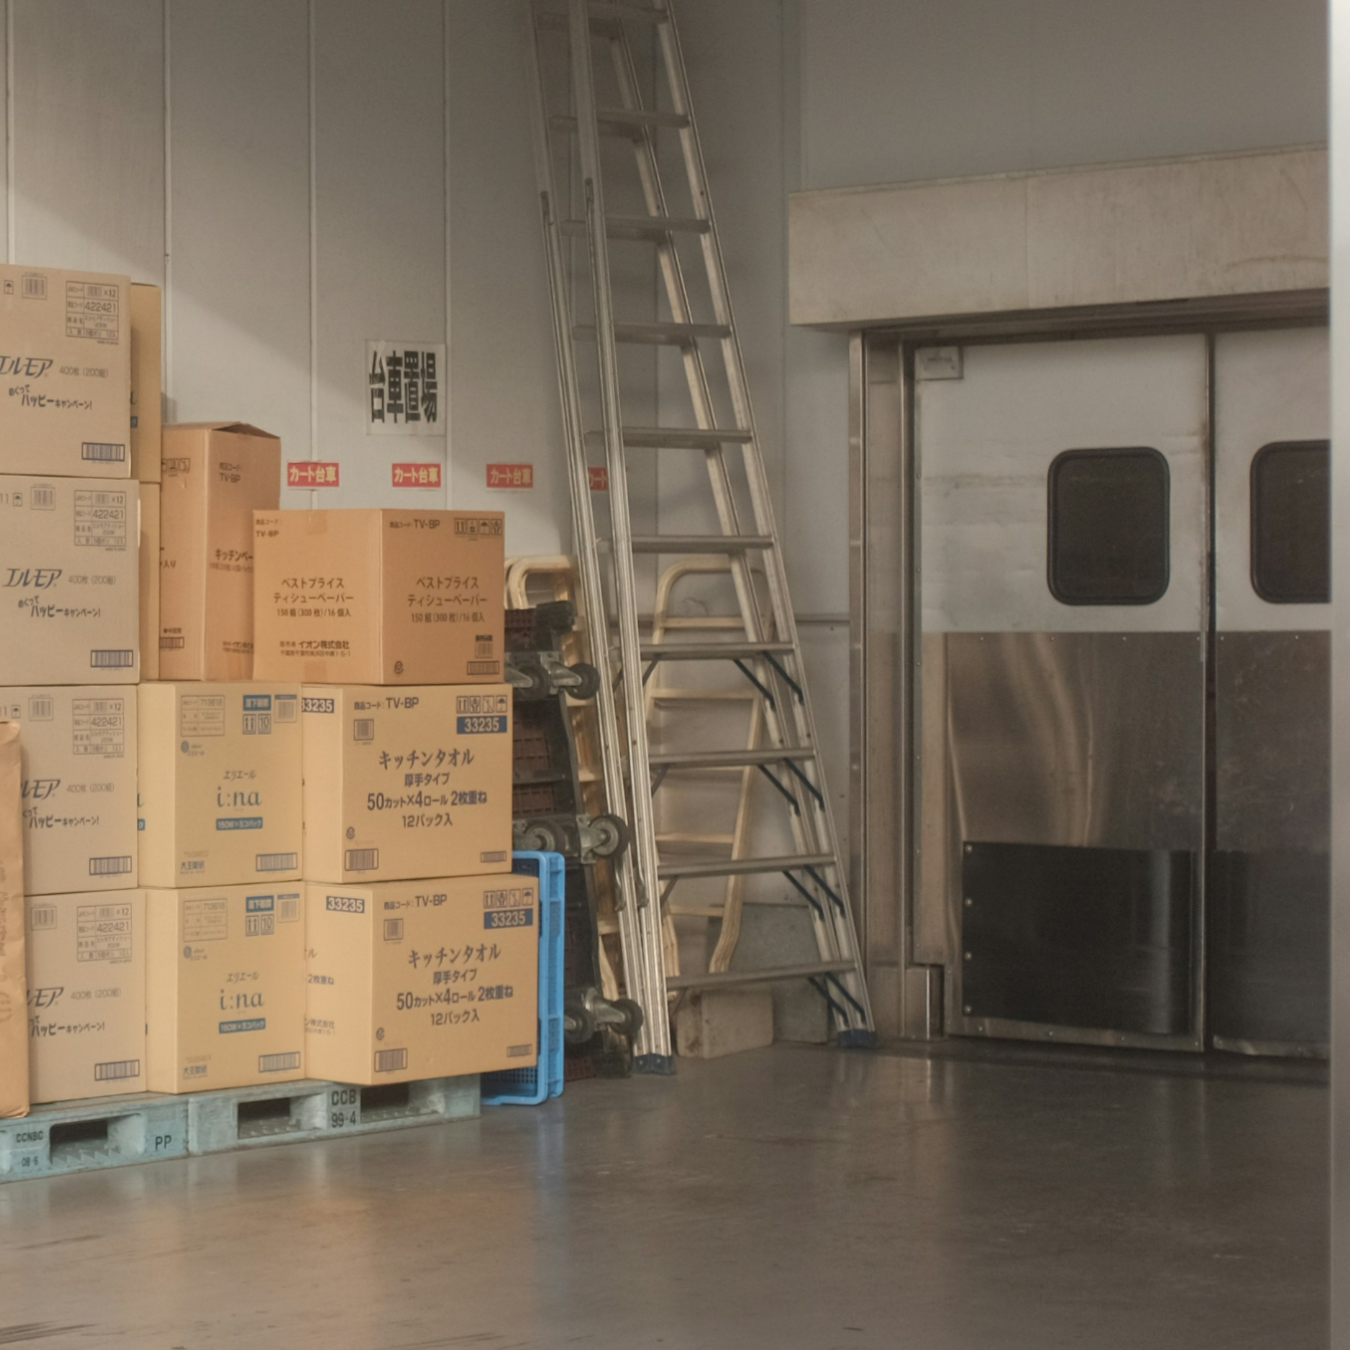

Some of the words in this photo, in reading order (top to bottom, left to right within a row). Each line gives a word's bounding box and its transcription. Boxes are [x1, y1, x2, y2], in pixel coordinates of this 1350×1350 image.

[84, 301, 117, 313] 422421
[368, 350, 438, 423] 台車置場
[289, 466, 337, 484] カート台車
[393, 466, 440, 484] カート台車
[490, 467, 532, 485] カート台車
[92, 509, 124, 520] 422421
[413, 519, 441, 530] TV-BP
[215, 549, 254, 562] キッチンペー
[2, 568, 63, 589] エルモア
[281, 577, 345, 590] ベストプライス
[416, 576, 479, 590] ベストプライス
[274, 592, 354, 604] ティシューペーパー
[408, 594, 488, 607] ティシューペーパー
[298, 640, 350, 650] イオン株式会社
[385, 697, 419, 709] TV-BP
[91, 716, 122, 727] 422421
[259, 716, 270, 729] 10
[464, 717, 500, 733] 33235
[379, 748, 475, 771] キッチンタオル
[223, 770, 256, 781] エリエール
[404, 772, 450, 787] 厚手タイプ
[21, 779, 61, 800] ルモア
[216, 786, 262, 808] i:na
[22, 806, 38, 818] くって
[402, 812, 453, 828] 12パック入
[328, 897, 364, 913] 33235
[415, 894, 447, 908] TV-BP
[262, 916, 272, 928] 10
[491, 910, 526, 927] 33235
[96, 921, 130, 933] 422421
[408, 943, 501, 969] キッチンタオル
[226, 971, 260, 983] エリエール
[308, 974, 335, 985] 2枚重ね
[433, 968, 478, 986] 厚手タイプ
[26, 986, 65, 1008] モア
[219, 989, 265, 1011] i:na
[431, 1009, 480, 1027] 12パック入
[332, 1088, 356, 1106] CCB
[16, 1130, 43, 1143] CCNBC
[155, 1134, 172, 1151] PP
